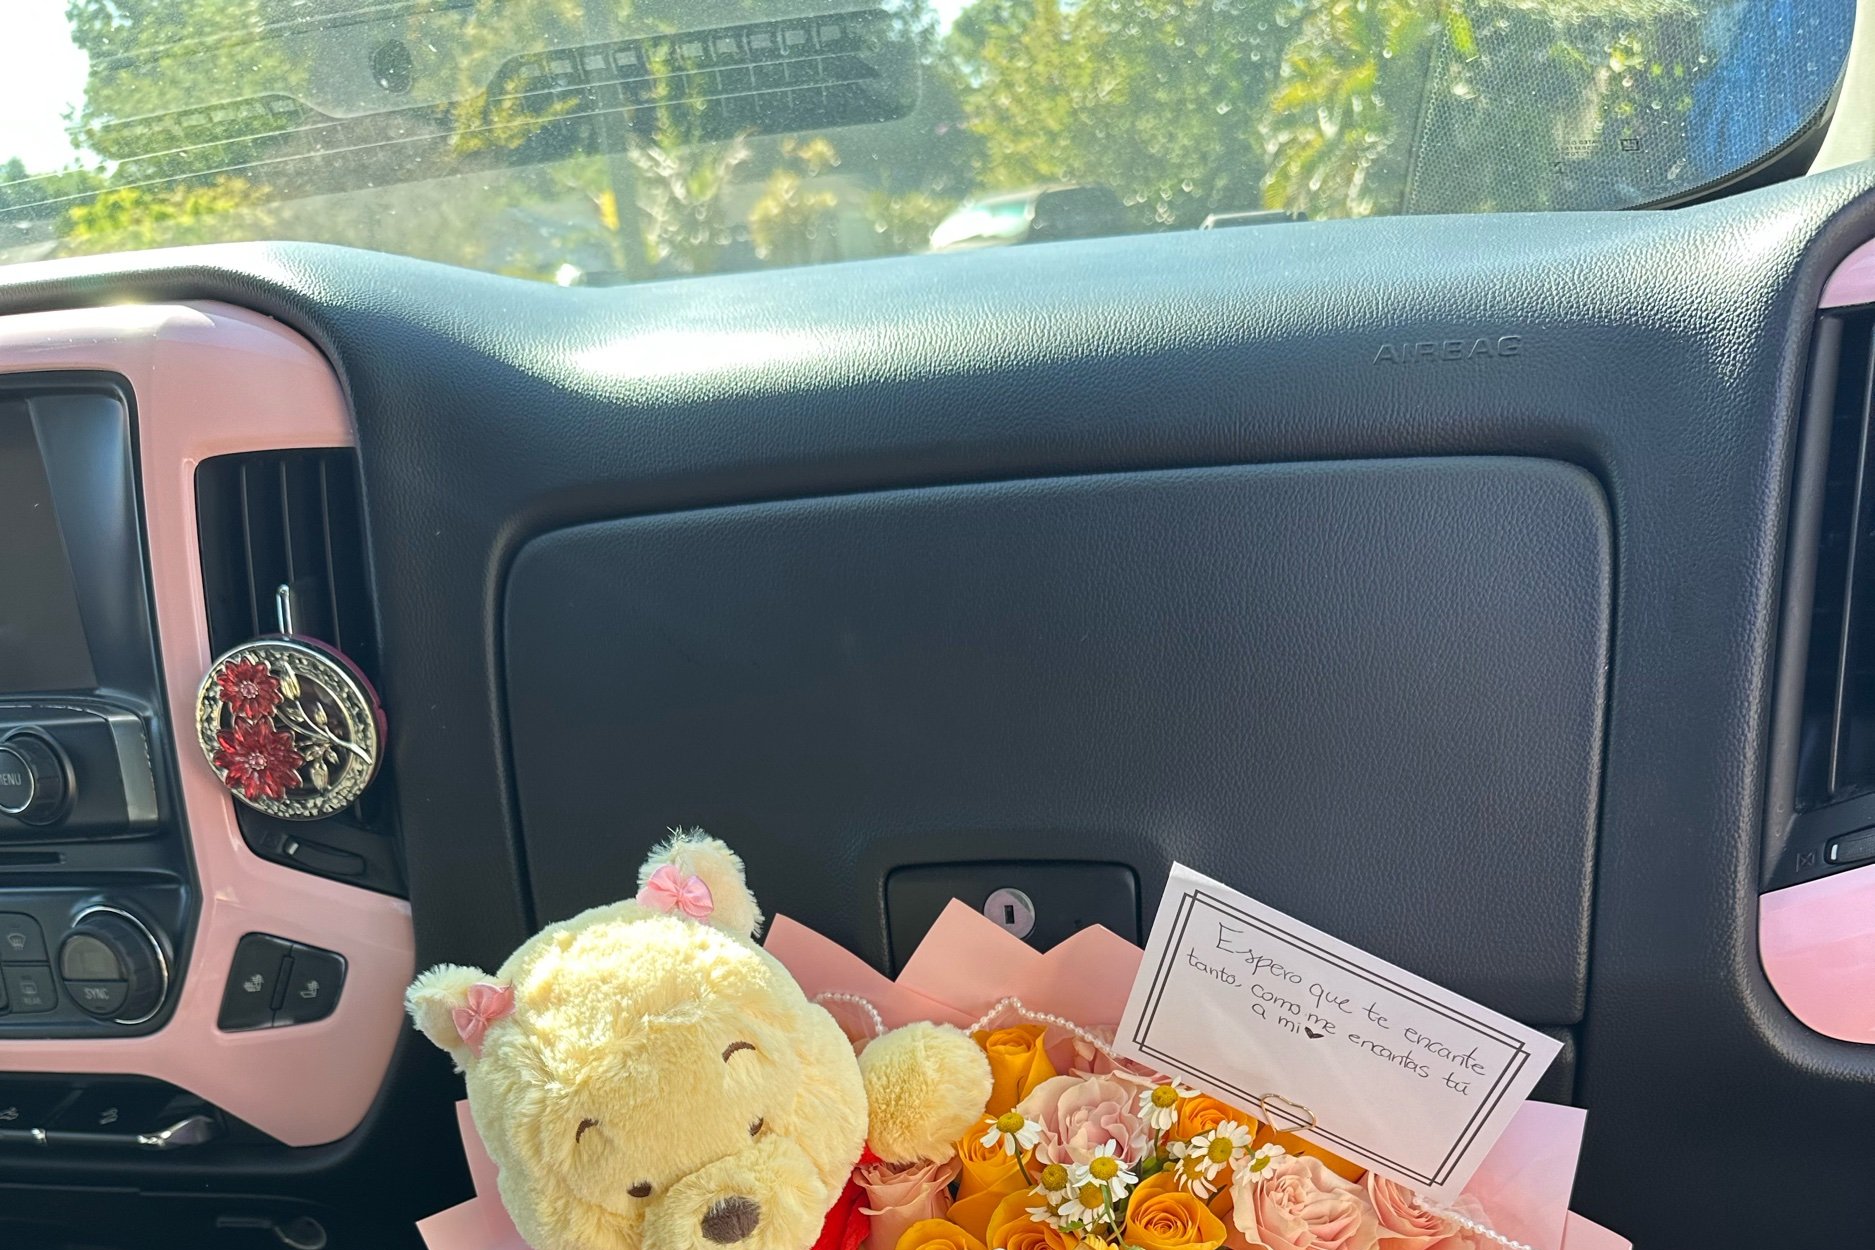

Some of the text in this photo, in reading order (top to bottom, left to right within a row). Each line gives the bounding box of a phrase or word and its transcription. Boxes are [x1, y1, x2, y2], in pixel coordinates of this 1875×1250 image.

[1373, 335, 1522, 366] AIRBAG
[84, 987, 110, 1001] SYNC
[1216, 921, 1486, 1076] Espero que te encante
[1251, 1003, 1267, 1020] a
[1251, 983, 1301, 1016] como
[1307, 1012, 1337, 1035] me
[1348, 1033, 1431, 1078] encantas
[1442, 1071, 1471, 1096] tú
